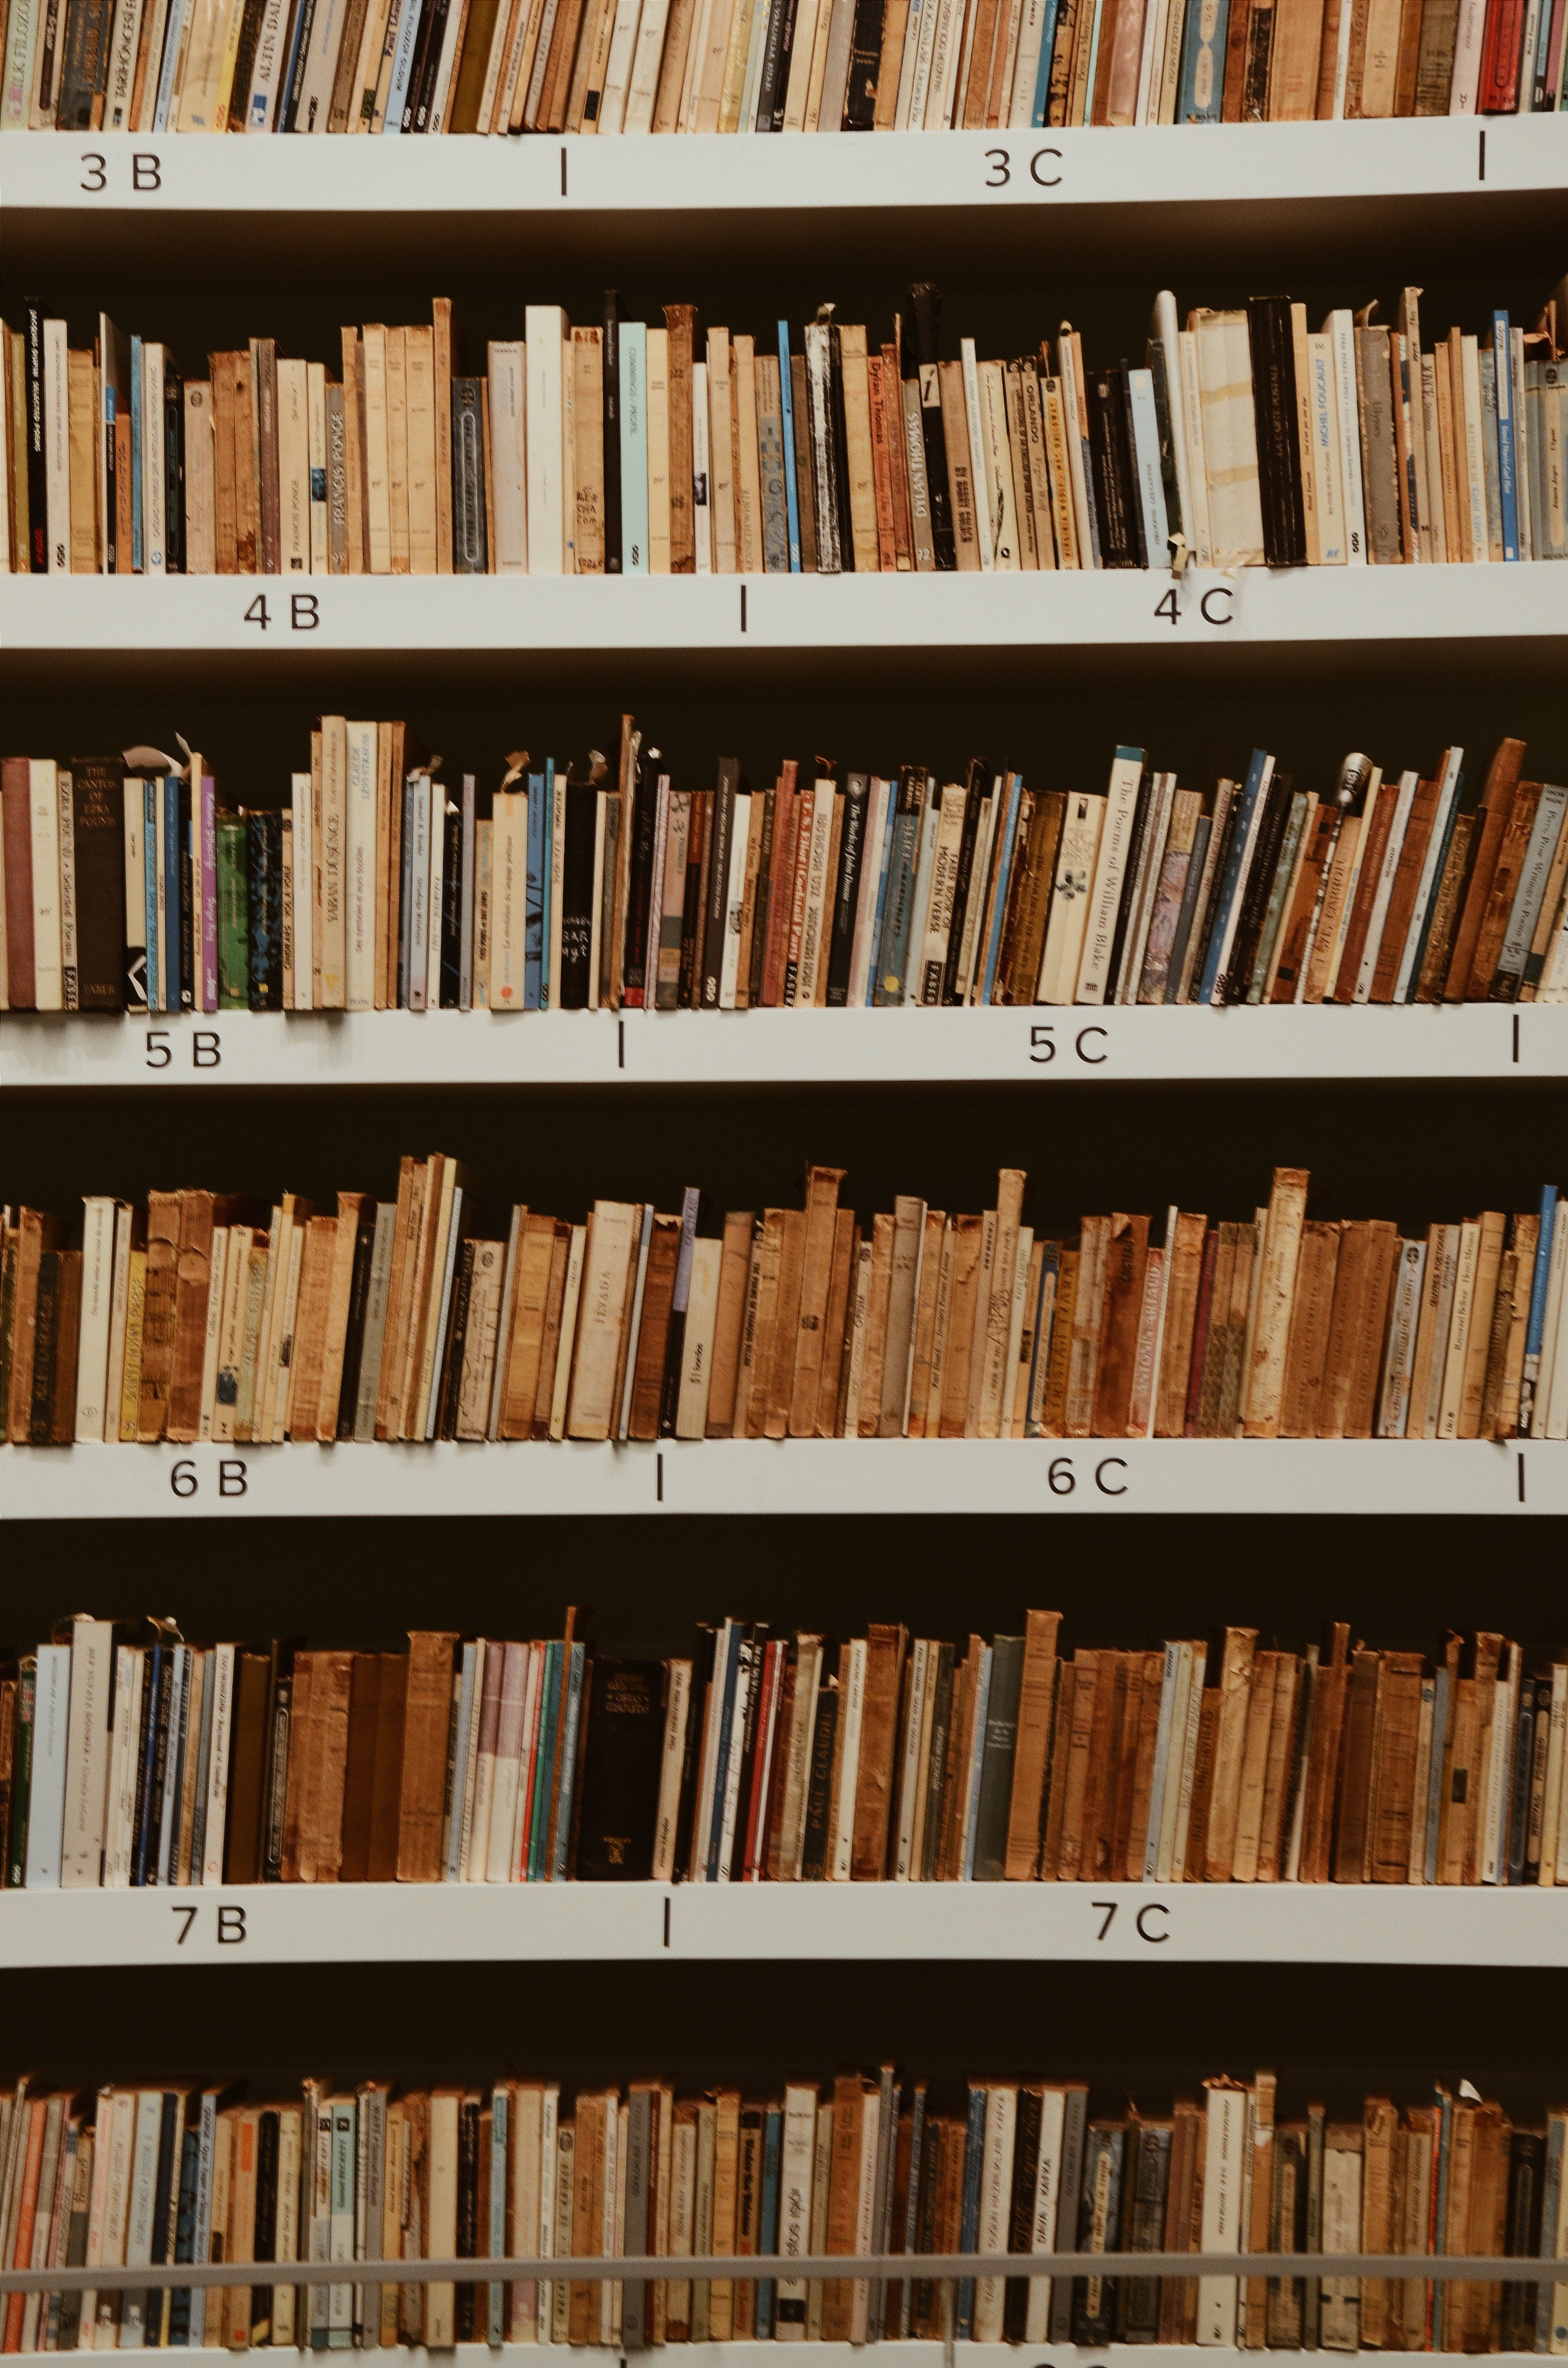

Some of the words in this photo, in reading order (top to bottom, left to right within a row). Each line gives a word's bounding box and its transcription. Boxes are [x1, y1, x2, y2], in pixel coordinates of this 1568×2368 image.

[259, 36, 276, 82] ALTIN
[81, 153, 107, 191] 3
[133, 154, 161, 191] B
[985, 149, 1010, 187] 3
[1030, 148, 1062, 186] C
[869, 362, 883, 395] Dylan
[1315, 358, 1327, 408] FOUCAULT
[873, 401, 885, 444] Thomas
[1026, 385, 1040, 444] ORLANDO
[1320, 411, 1330, 447] MICHEL
[331, 411, 344, 461] PONGE
[908, 411, 923, 470] THOMAS
[332, 465, 346, 524] FRANCIS
[912, 470, 928, 518] DYLAN
[292, 515, 301, 552] FRANCIS
[244, 594, 271, 629] 4
[291, 594, 319, 629] B
[1154, 589, 1181, 625] 4
[1200, 588, 1233, 625] C
[851, 803, 861, 819] The
[1118, 778, 1134, 804] The
[325, 813, 341, 876] DÜŞÜNCE
[845, 844, 857, 854] of
[847, 820, 859, 844] Works
[1110, 808, 1128, 852] Poems
[844, 854, 857, 873] John
[933, 845, 948, 897] MODERN
[1108, 855, 1122, 874] of
[62, 873, 73, 916] Selected
[326, 882, 339, 923] YABAN
[792, 870, 807, 923] Cocktail
[1098, 876, 1118, 929] William
[930, 900, 943, 934] VERSE
[788, 925, 802, 961] Party
[1091, 933, 1109, 971] Blake
[784, 965, 797, 1006] FABER
[926, 962, 940, 1004] FABER
[146, 1031, 172, 1068] 5
[193, 1032, 221, 1068] B
[1029, 1026, 1055, 1063] 5
[1076, 1026, 1108, 1064] C
[1055, 1266, 1074, 1325] TZARA
[1142, 1265, 1161, 1325] ARTAUD
[1050, 1334, 1068, 1408] TRISTAN
[1137, 1331, 1155, 1394] ANTONIN
[171, 1460, 198, 1497] 6
[219, 1460, 247, 1497] B
[1048, 1457, 1076, 1495] 6
[1095, 1457, 1127, 1495] C
[814, 1710, 834, 1779] CLAUDEL
[809, 1788, 826, 1829] PAUL
[172, 1906, 197, 1944] 7
[218, 1906, 246, 1944] B
[1092, 1902, 1118, 1940] 7
[1136, 1903, 1169, 1943] C
[1040, 2158, 1052, 2197] KAFKA
[1037, 2213, 1048, 2244] DAVA
